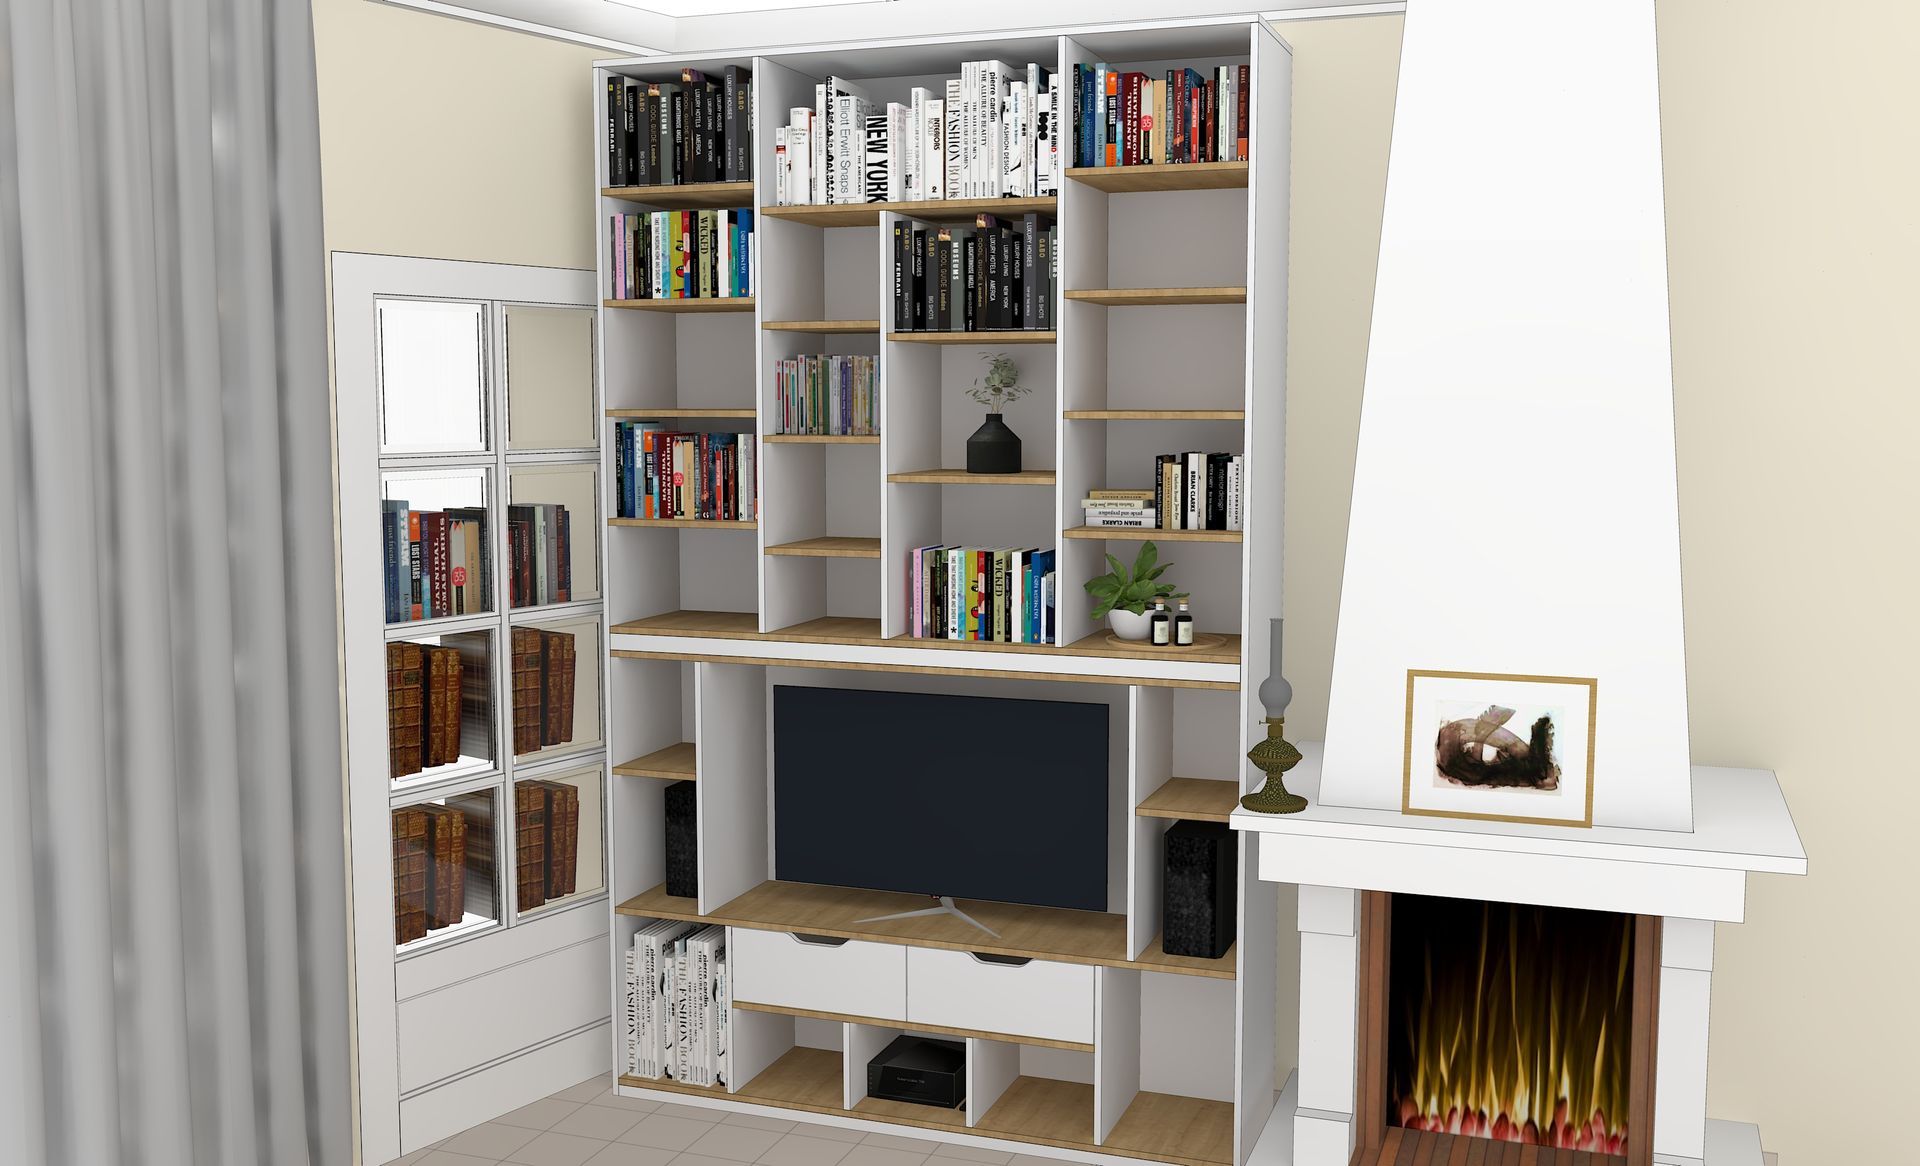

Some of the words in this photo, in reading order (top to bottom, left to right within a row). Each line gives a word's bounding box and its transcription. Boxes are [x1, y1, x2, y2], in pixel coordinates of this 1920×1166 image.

[948, 81, 960, 108] THE
[989, 72, 997, 95] pierre
[840, 99, 851, 126] Elliott
[981, 110, 987, 119] OF
[1037, 112, 1049, 140] logo
[1143, 119, 1151, 127] 35
[840, 129, 851, 157] Erwitt
[867, 117, 888, 153] NEW
[948, 110, 961, 162] FASHION
[972, 137, 978, 145] OF
[838, 160, 851, 193] Snaps
[867, 160, 888, 204] YORK
[948, 165, 961, 198] BOOK
[700, 216, 709, 255] WICKED
[400, 509, 410, 566] STEAM
[411, 544, 420, 558] LOST
[388, 540, 396, 568] friends
[412, 560, 420, 579] STARS
[454, 571, 465, 582] 35
[995, 559, 1003, 597] WICKED
[626, 953, 634, 979] THE
[678, 959, 687, 986] THE
[627, 981, 635, 1036] FASHION
[679, 988, 687, 1042] FASHION
